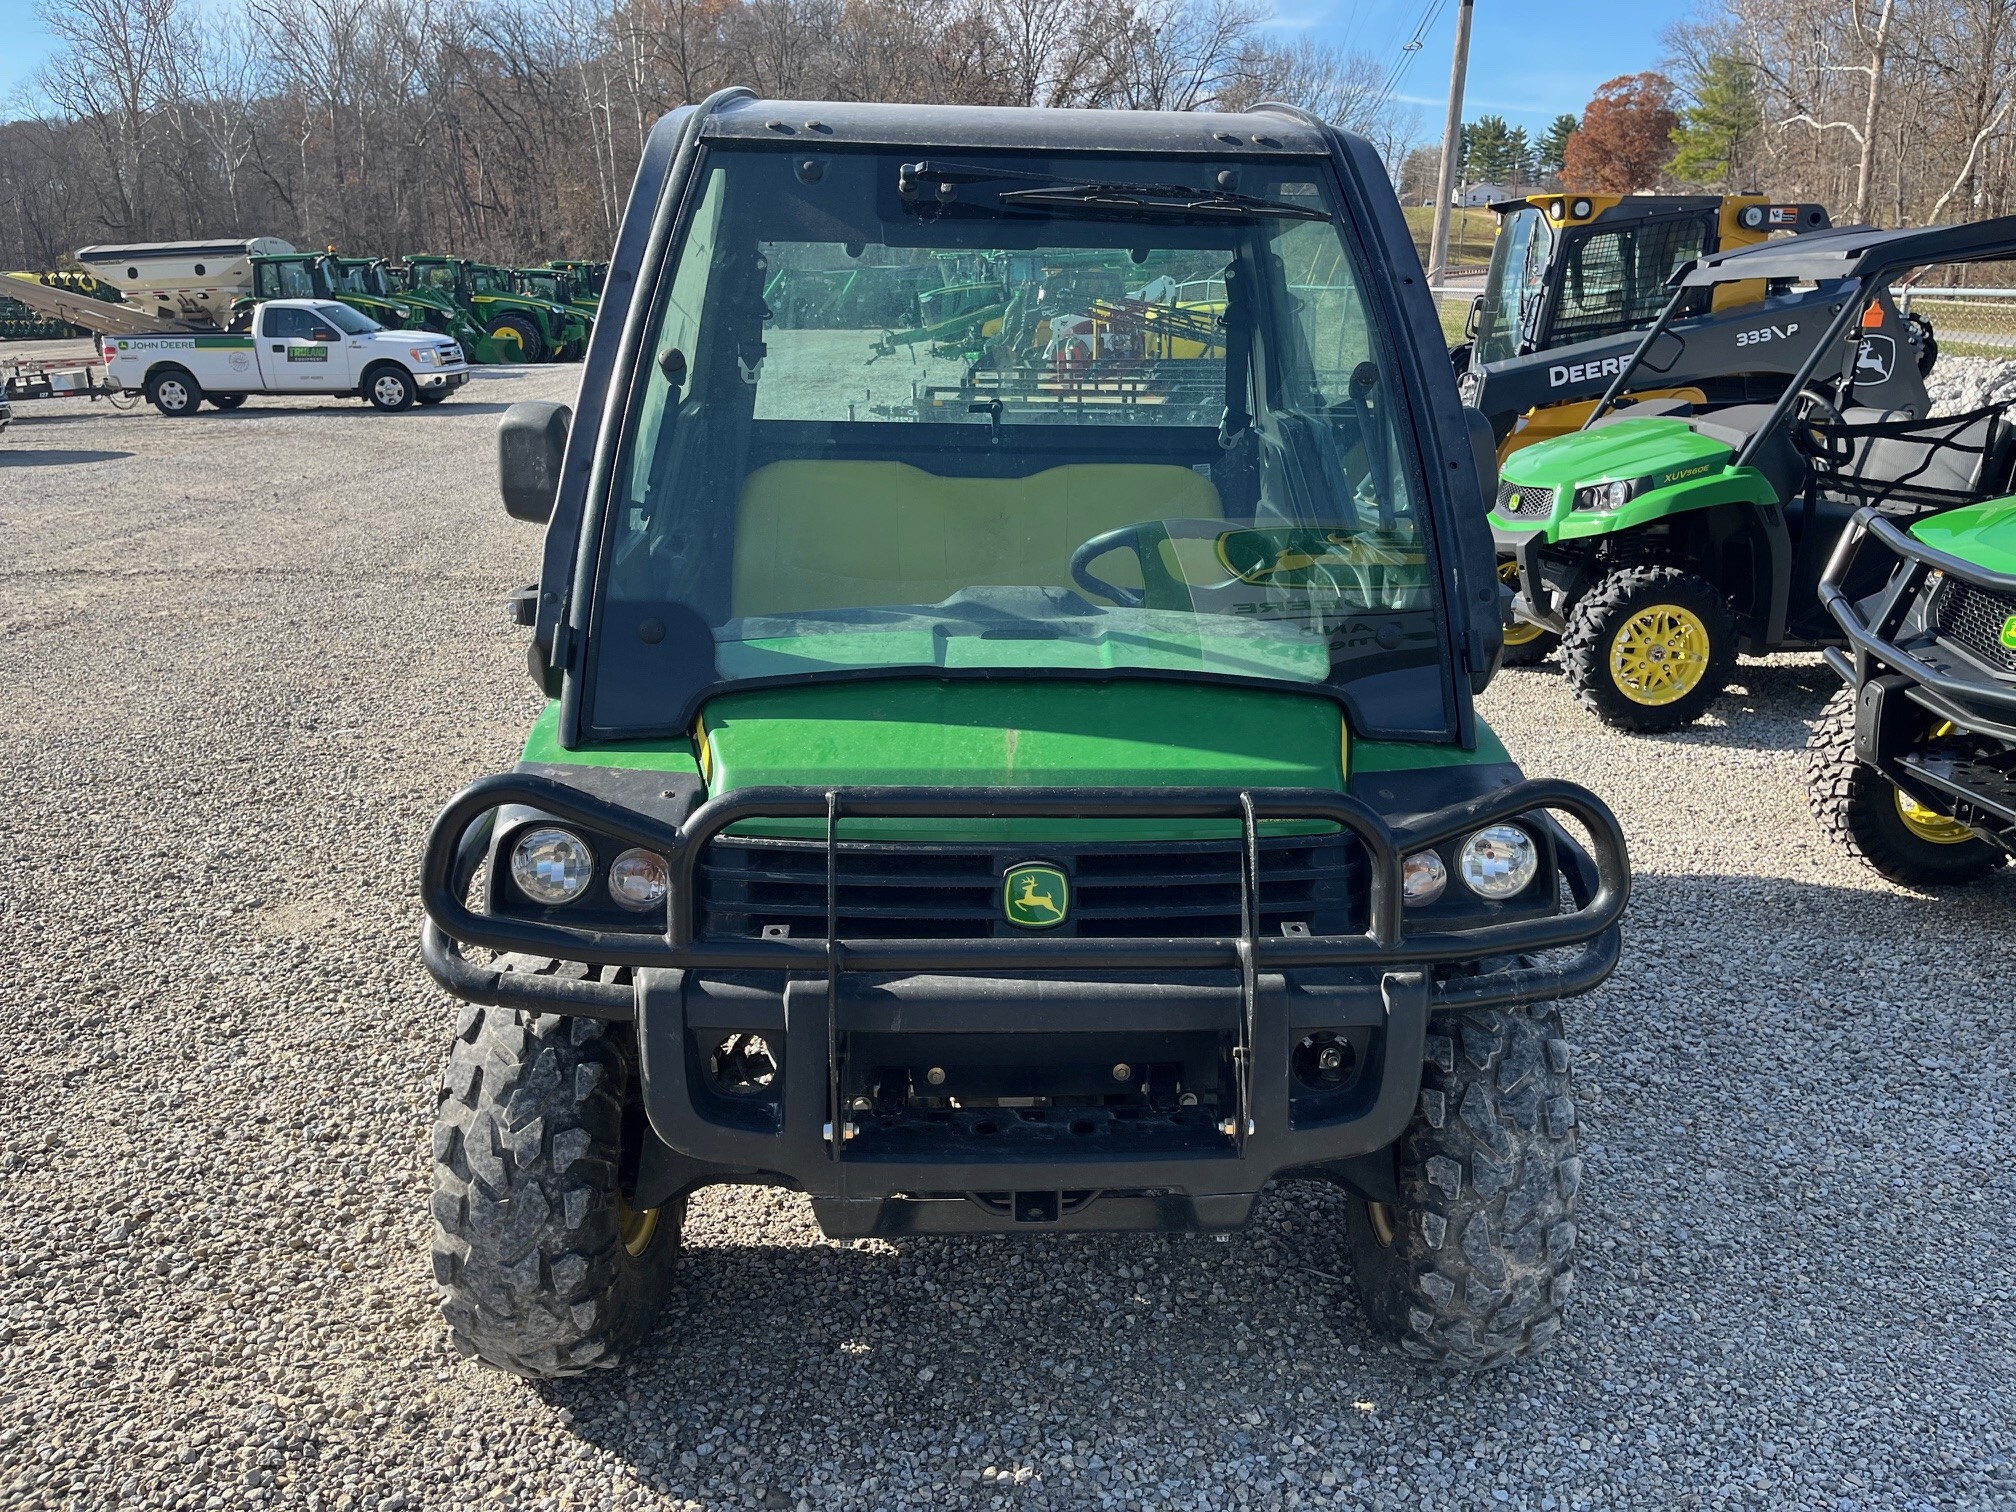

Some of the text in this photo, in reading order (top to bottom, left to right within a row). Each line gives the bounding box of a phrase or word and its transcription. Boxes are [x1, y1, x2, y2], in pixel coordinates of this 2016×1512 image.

[131, 340, 195, 349] JOHN DEERE
[1664, 464, 1710, 483] XUV560E
